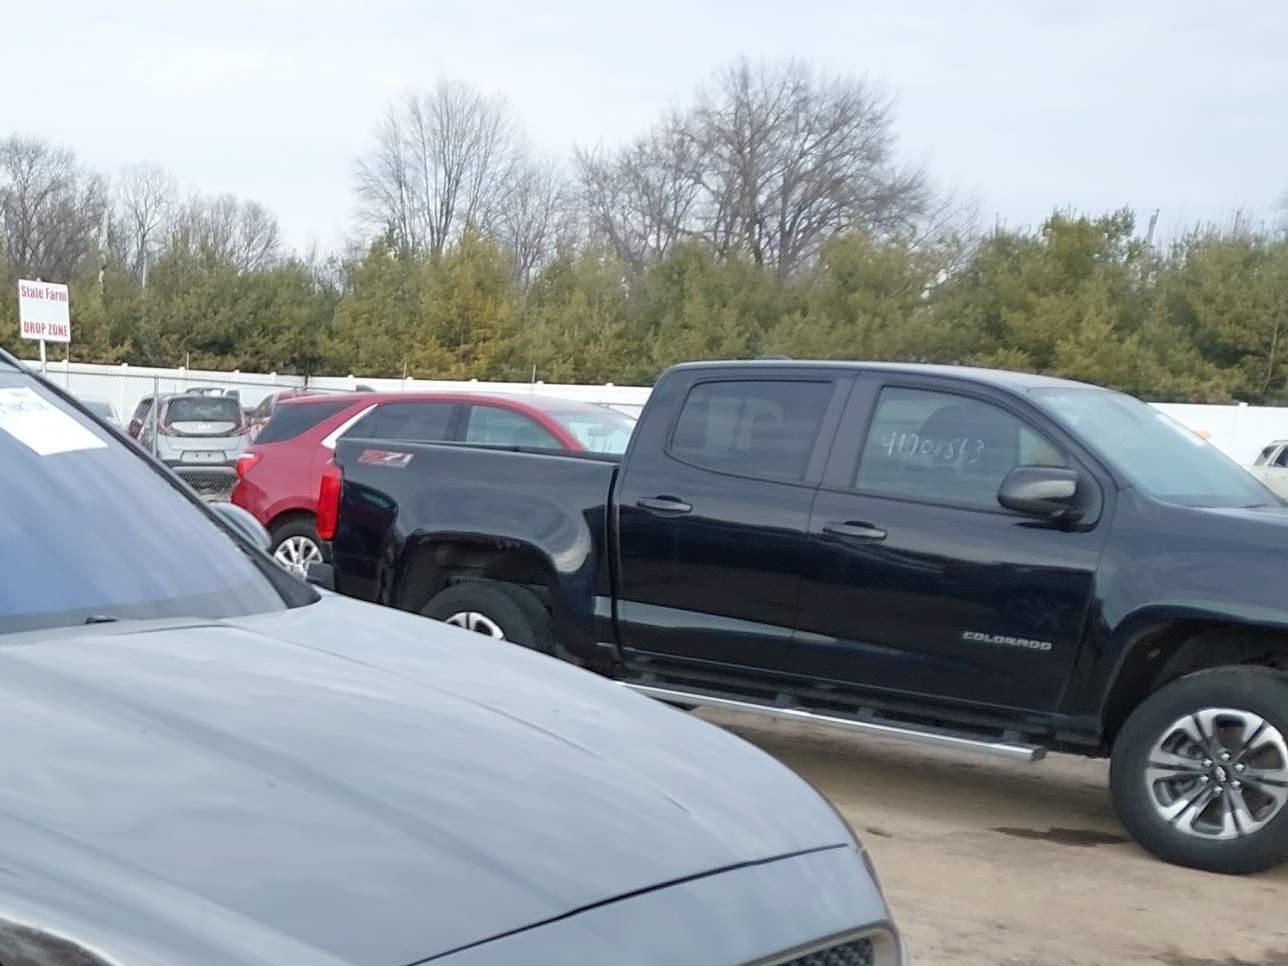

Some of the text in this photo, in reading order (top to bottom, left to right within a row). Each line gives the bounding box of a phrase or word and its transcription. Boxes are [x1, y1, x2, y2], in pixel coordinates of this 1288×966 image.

[21, 286, 67, 302] State Farm
[24, 321, 68, 336] DROP ZONE
[358, 449, 414, 463] Z71
[962, 631, 1053, 650] COLORADO
